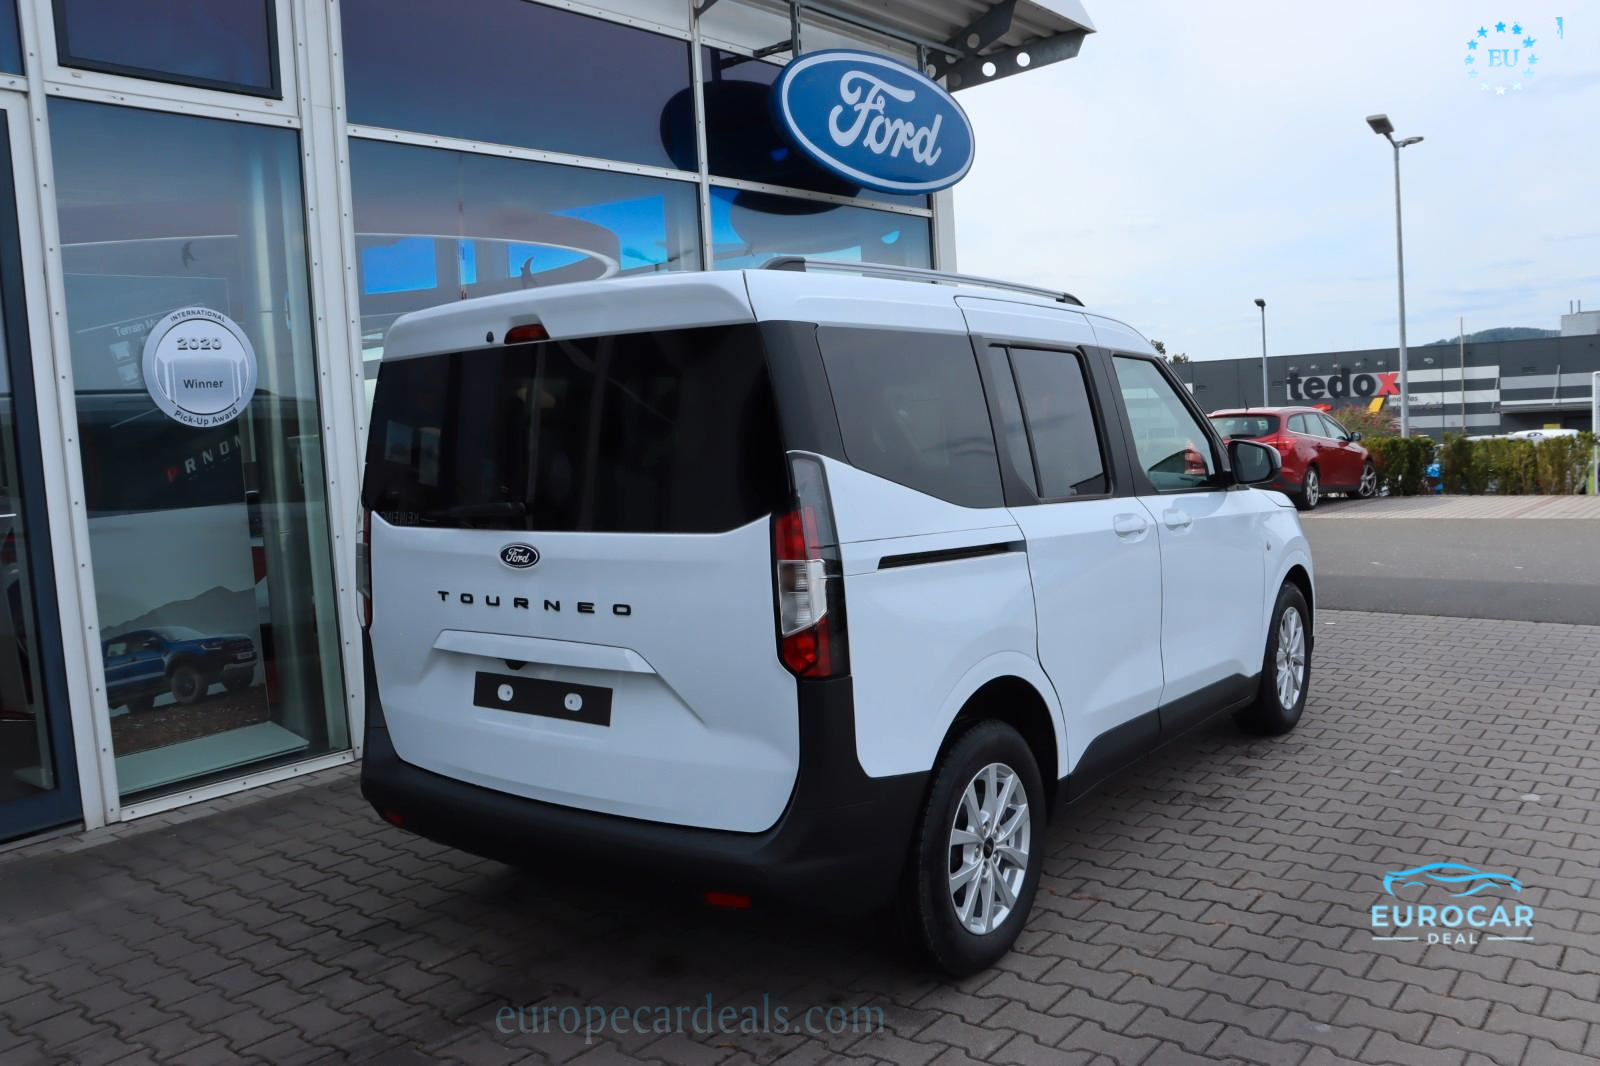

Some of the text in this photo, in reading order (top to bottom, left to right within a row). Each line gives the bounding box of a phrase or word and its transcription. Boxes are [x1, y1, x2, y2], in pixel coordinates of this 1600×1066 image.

[828, 70, 943, 167] Ford
[170, 309, 226, 323] INTERNATIONAL
[176, 336, 223, 351] 2020
[183, 379, 224, 389] Winner
[1285, 368, 1401, 400] tedox
[174, 407, 239, 426] Pick-Up Award
[505, 547, 530, 564] Ford
[437, 590, 632, 616] TOURNEO
